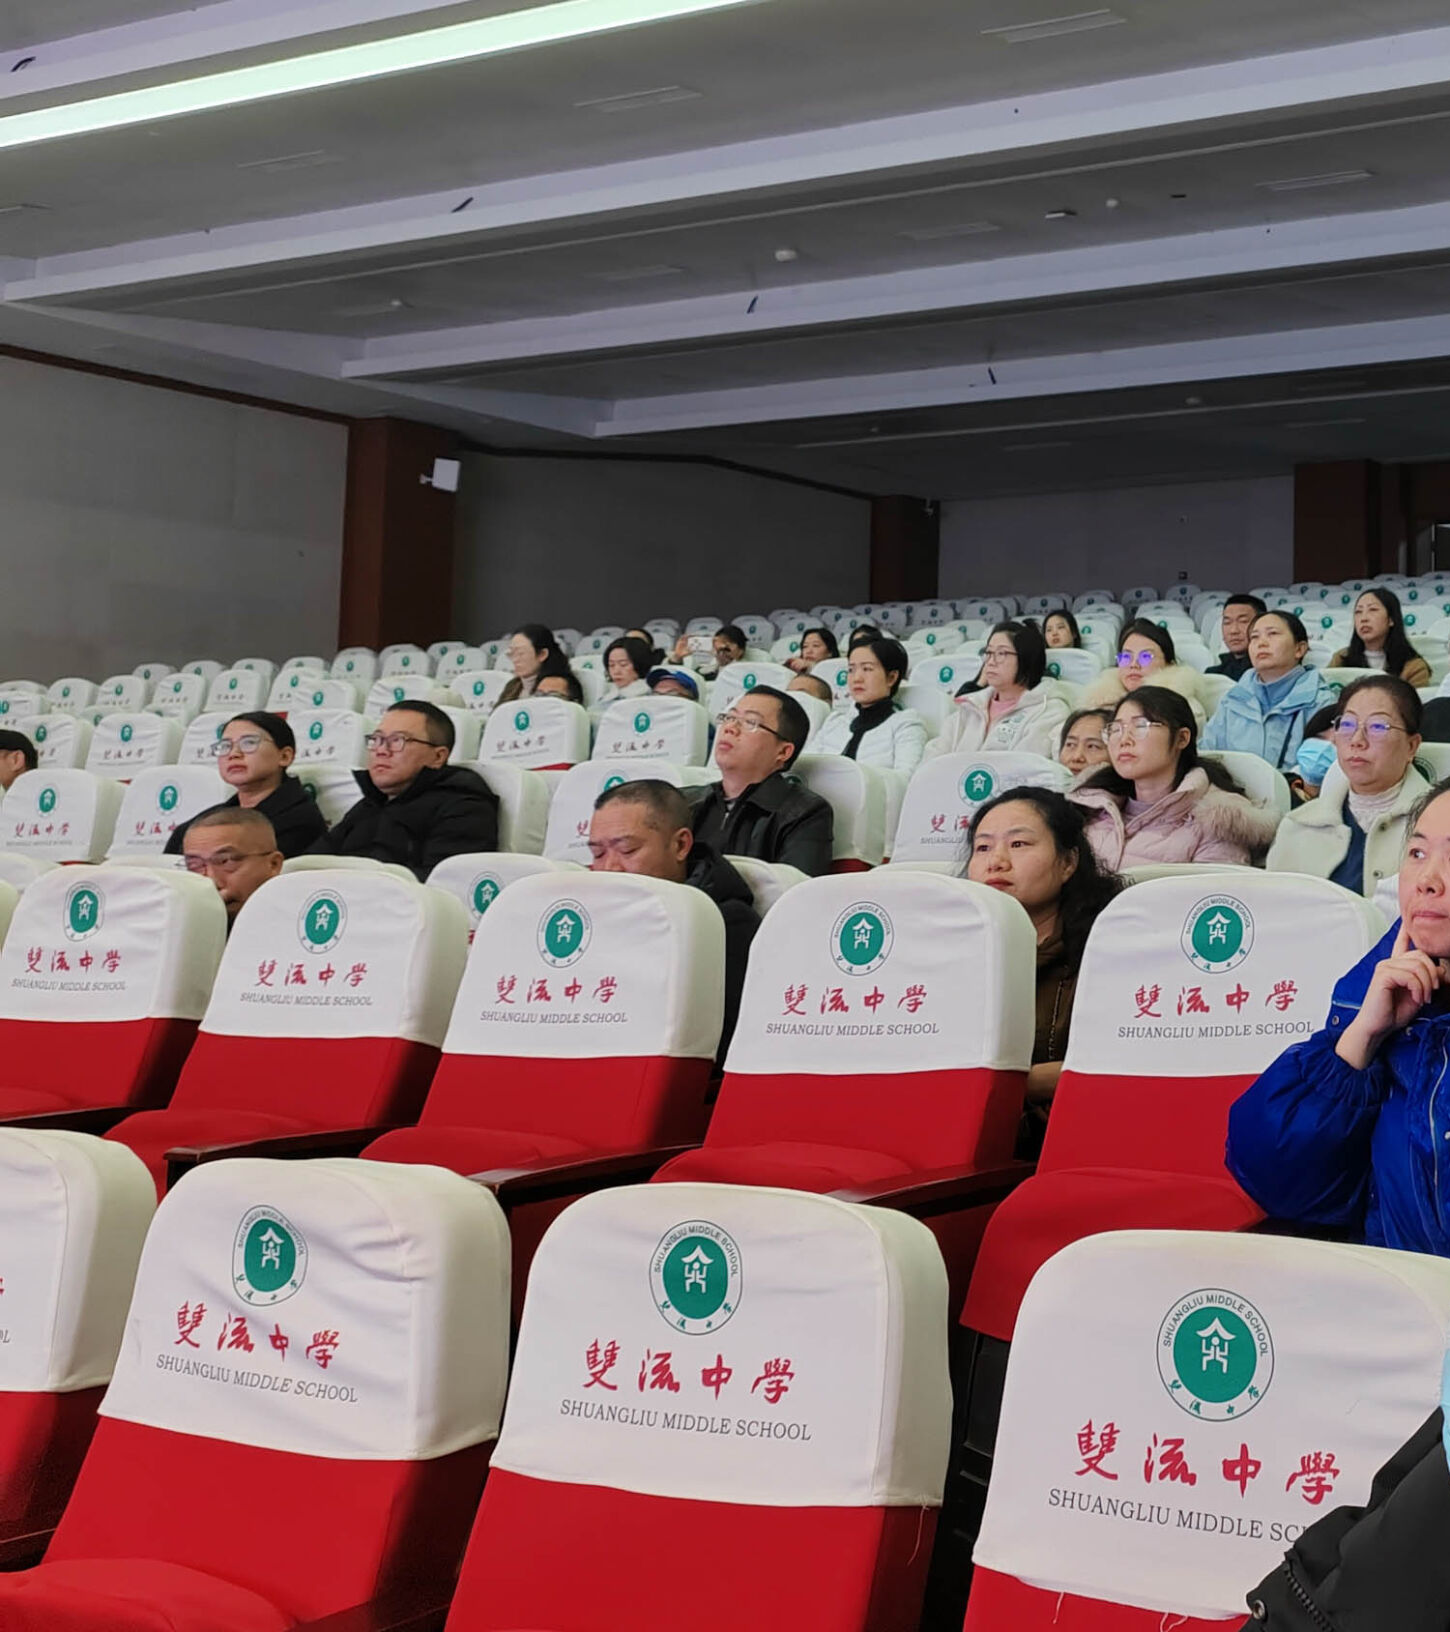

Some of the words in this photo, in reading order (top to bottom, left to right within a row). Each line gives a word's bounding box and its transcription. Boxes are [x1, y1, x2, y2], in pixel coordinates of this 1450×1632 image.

[495, 974, 618, 1004] 雙流中學
[782, 983, 927, 1016] 雙流中學
[1133, 979, 1299, 1019] 雙流中學
[480, 1011, 538, 1024] SHUANGLIU
[539, 1013, 581, 1024] MIDDLE
[582, 1012, 628, 1023] SCHOOL
[766, 1023, 834, 1036] SHUANGLIU
[836, 1024, 885, 1036] MIDDLE
[887, 1022, 940, 1035] SCHOOL
[1118, 1026, 1195, 1039] SHUANGLIU
[1198, 1024, 1252, 1038] MIDDLE
[1255, 1021, 1314, 1035] SCHOOL
[688, 1225, 721, 1241] MIDDLE
[174, 1300, 340, 1370] 雙流中學
[1162, 1295, 1205, 1348] SHUANGLIU
[1205, 1294, 1245, 1314] MIDDLE
[1245, 1311, 1269, 1357] SCHOOL
[156, 1354, 231, 1383] SHUANGLIU
[233, 1370, 293, 1393] MIDDLE
[294, 1380, 358, 1403] SCHOOL
[582, 1338, 795, 1404] 雙流中學
[560, 1399, 658, 1427] SHUANGLIU
[661, 1412, 731, 1435] MIDDLE
[735, 1419, 812, 1441] SCHOOL
[1075, 1418, 1340, 1505] 雙流中學
[1049, 1488, 1171, 1525] SHUANGLIU
[1175, 1509, 1264, 1540] MIDDLE
